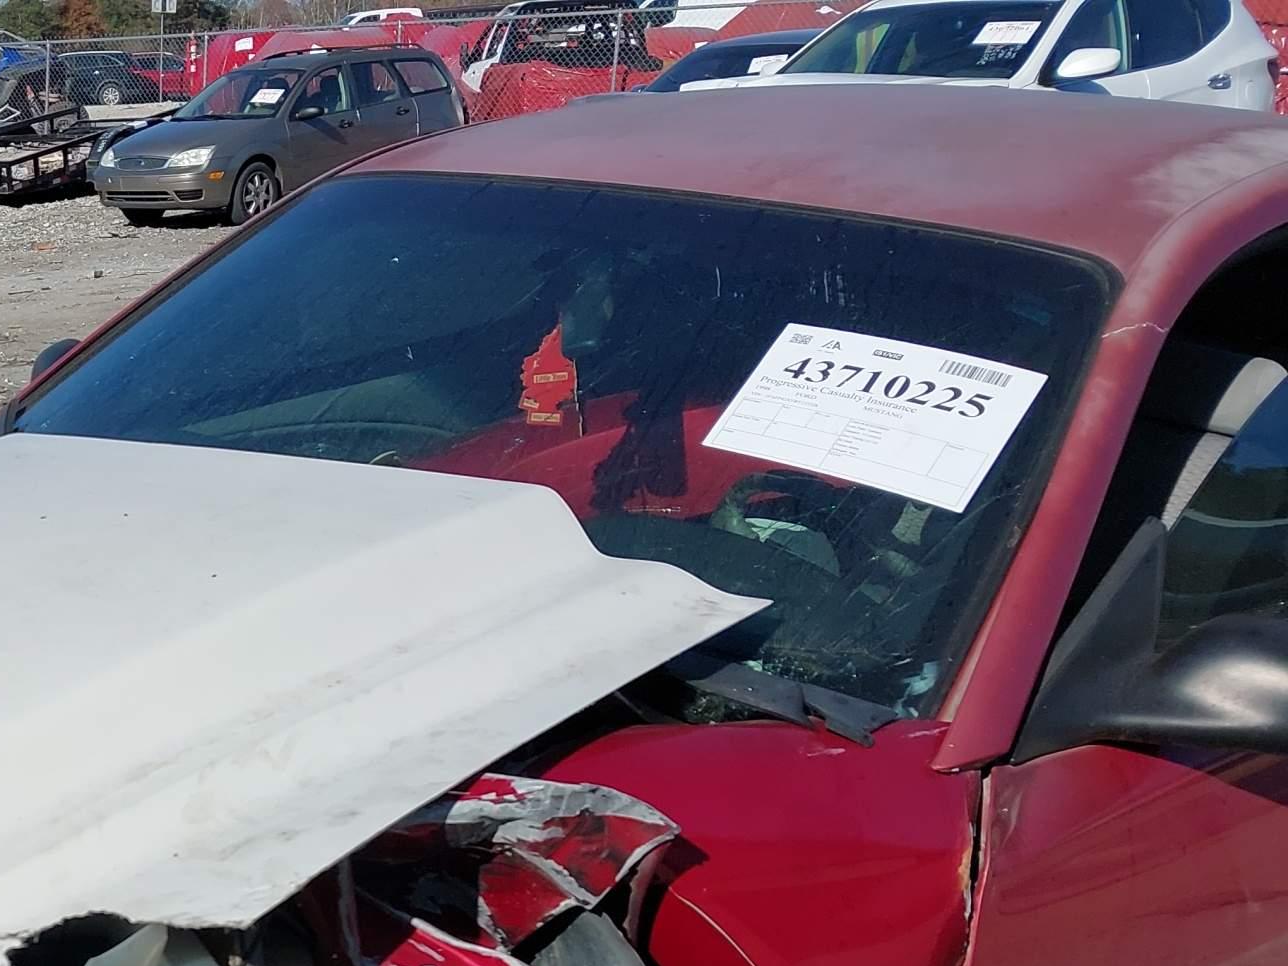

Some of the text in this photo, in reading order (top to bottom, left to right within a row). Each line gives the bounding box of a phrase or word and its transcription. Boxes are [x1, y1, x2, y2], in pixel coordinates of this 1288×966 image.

[759, 375, 819, 392] Progressive
[819, 386, 864, 403] Casualty
[865, 395, 918, 414] Insurance
[783, 357, 994, 418] 43710225
[863, 405, 904, 420] MUSTANG
